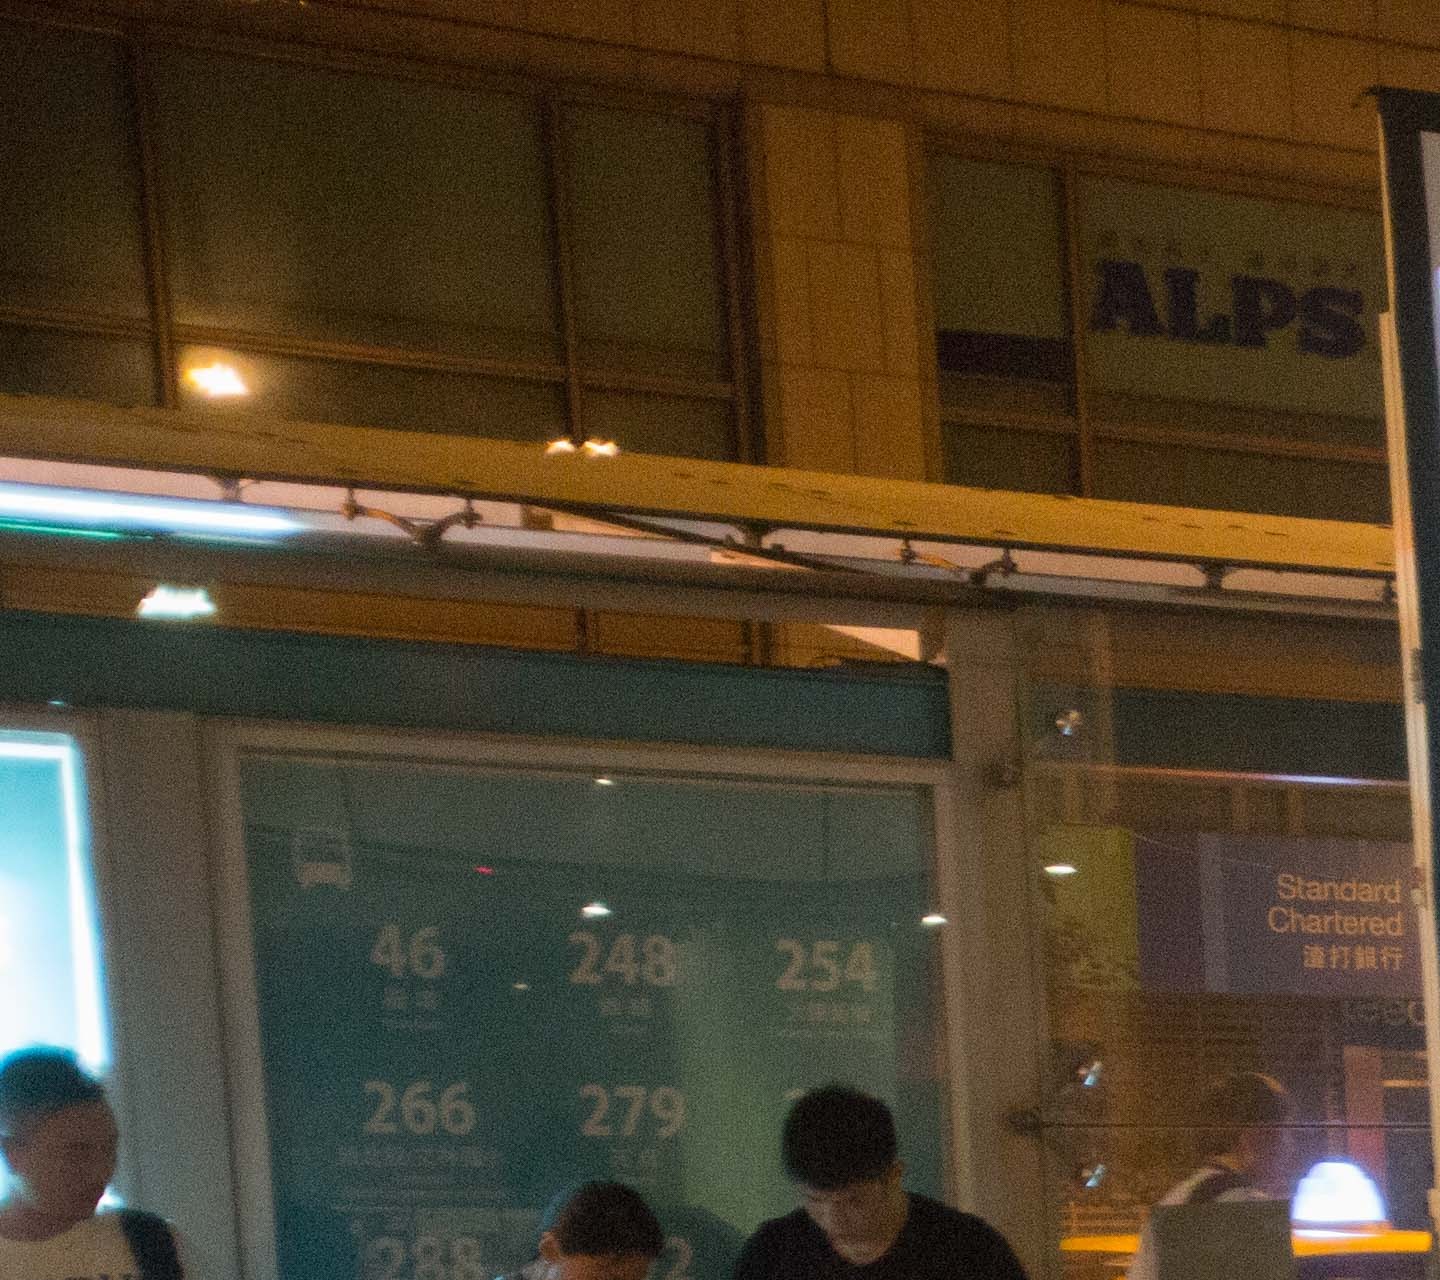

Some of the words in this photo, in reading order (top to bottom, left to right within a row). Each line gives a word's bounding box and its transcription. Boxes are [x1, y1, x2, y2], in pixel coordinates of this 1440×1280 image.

[1088, 256, 1367, 360] ALPS
[1277, 873, 1401, 904] Standard
[1267, 905, 1403, 937] Chartered
[369, 923, 447, 979] 46
[569, 930, 678, 987] 248
[776, 938, 874, 993] 254
[363, 1080, 477, 1136] 266
[578, 1083, 688, 1138] 279
